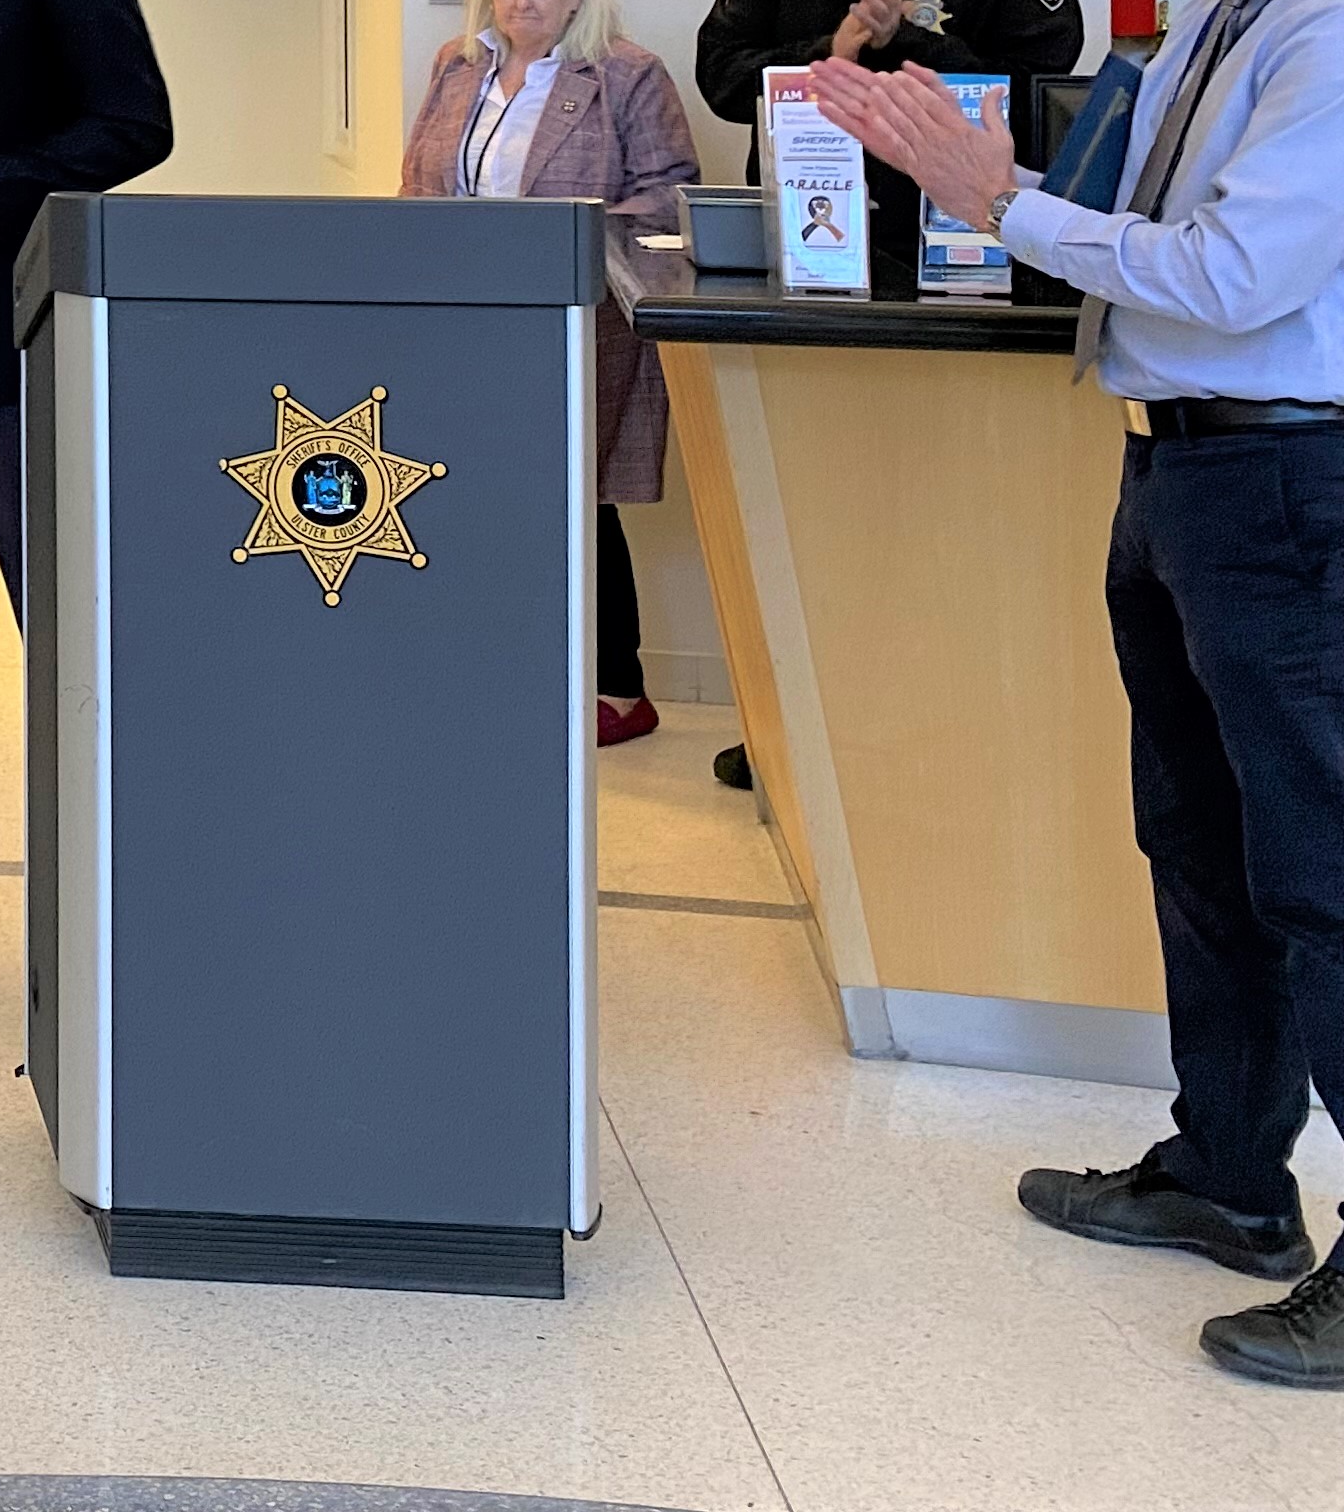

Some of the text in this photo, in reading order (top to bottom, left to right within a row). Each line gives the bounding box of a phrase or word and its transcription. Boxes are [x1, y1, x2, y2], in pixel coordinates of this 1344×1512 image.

[775, 90, 803, 101] I AM
[792, 136, 849, 145] SHERIFF
[286, 440, 371, 469] SHERIFF'S OFFICE
[291, 512, 370, 540] ULSTER COUNTY
